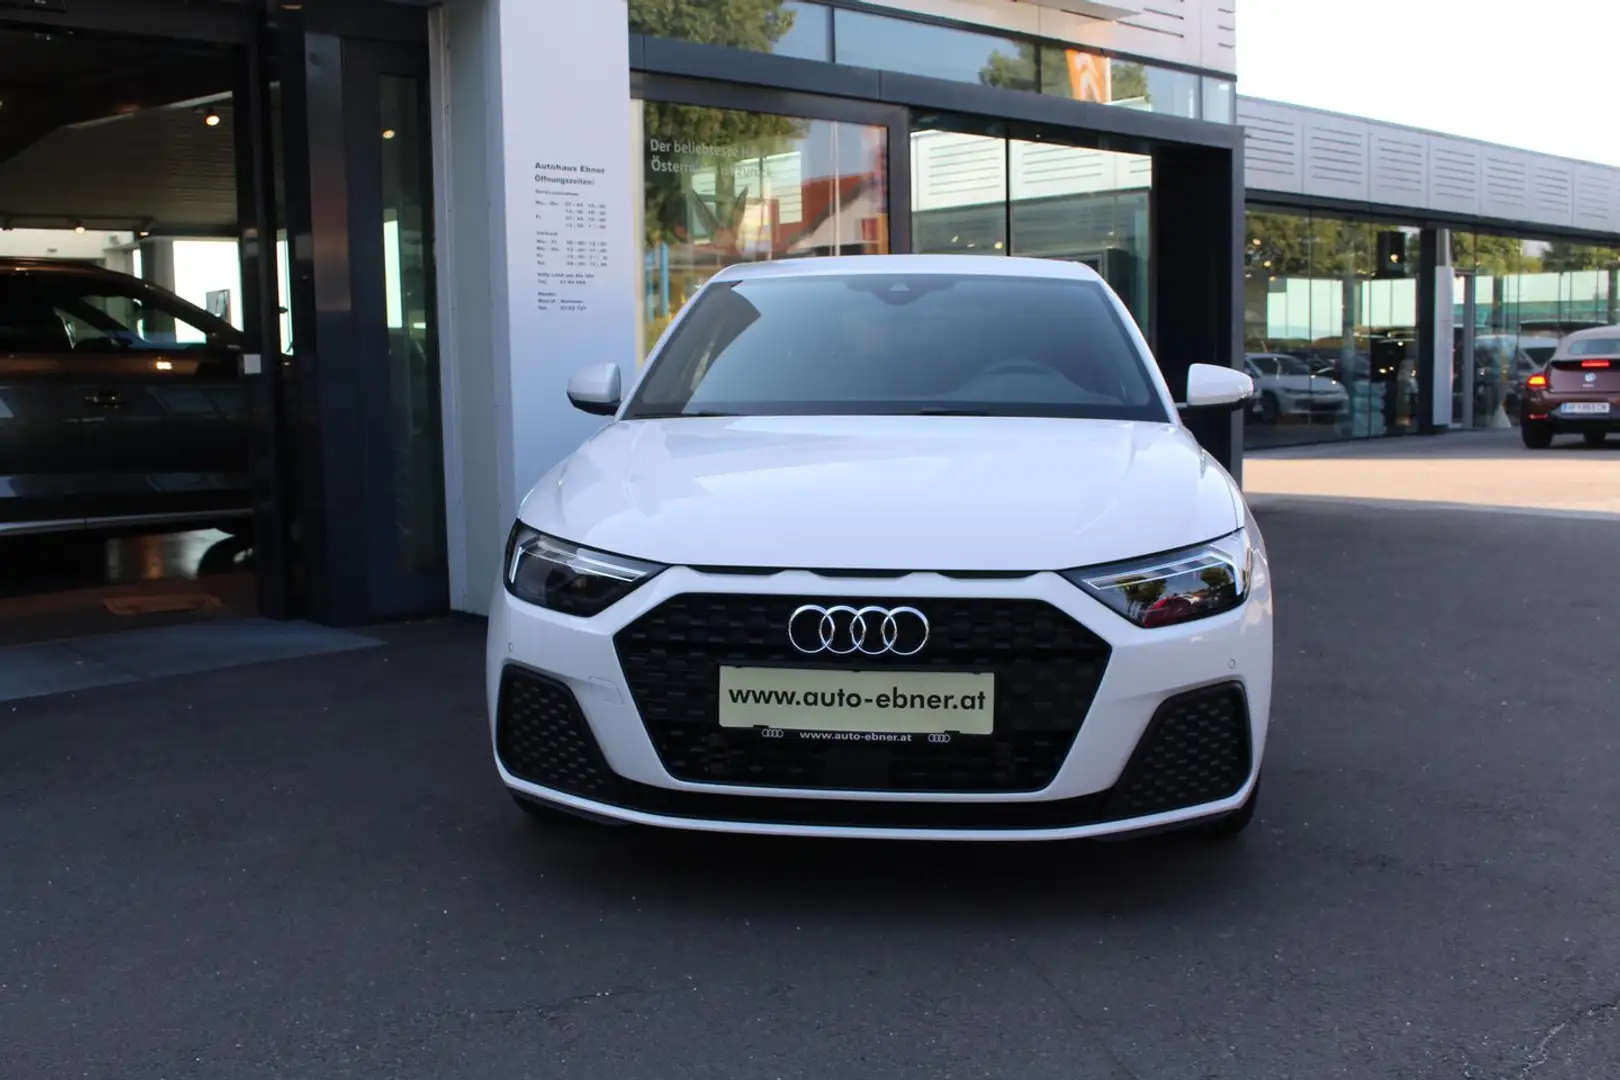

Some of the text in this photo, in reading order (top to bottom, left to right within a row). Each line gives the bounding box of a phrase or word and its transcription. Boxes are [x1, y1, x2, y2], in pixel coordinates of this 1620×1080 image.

[650, 139, 671, 153] Der
[535, 162, 605, 174] Autohaus Ebner
[729, 686, 985, 710] www.auto-ebner.at
[800, 730, 912, 742] www.auto-ebner.at
